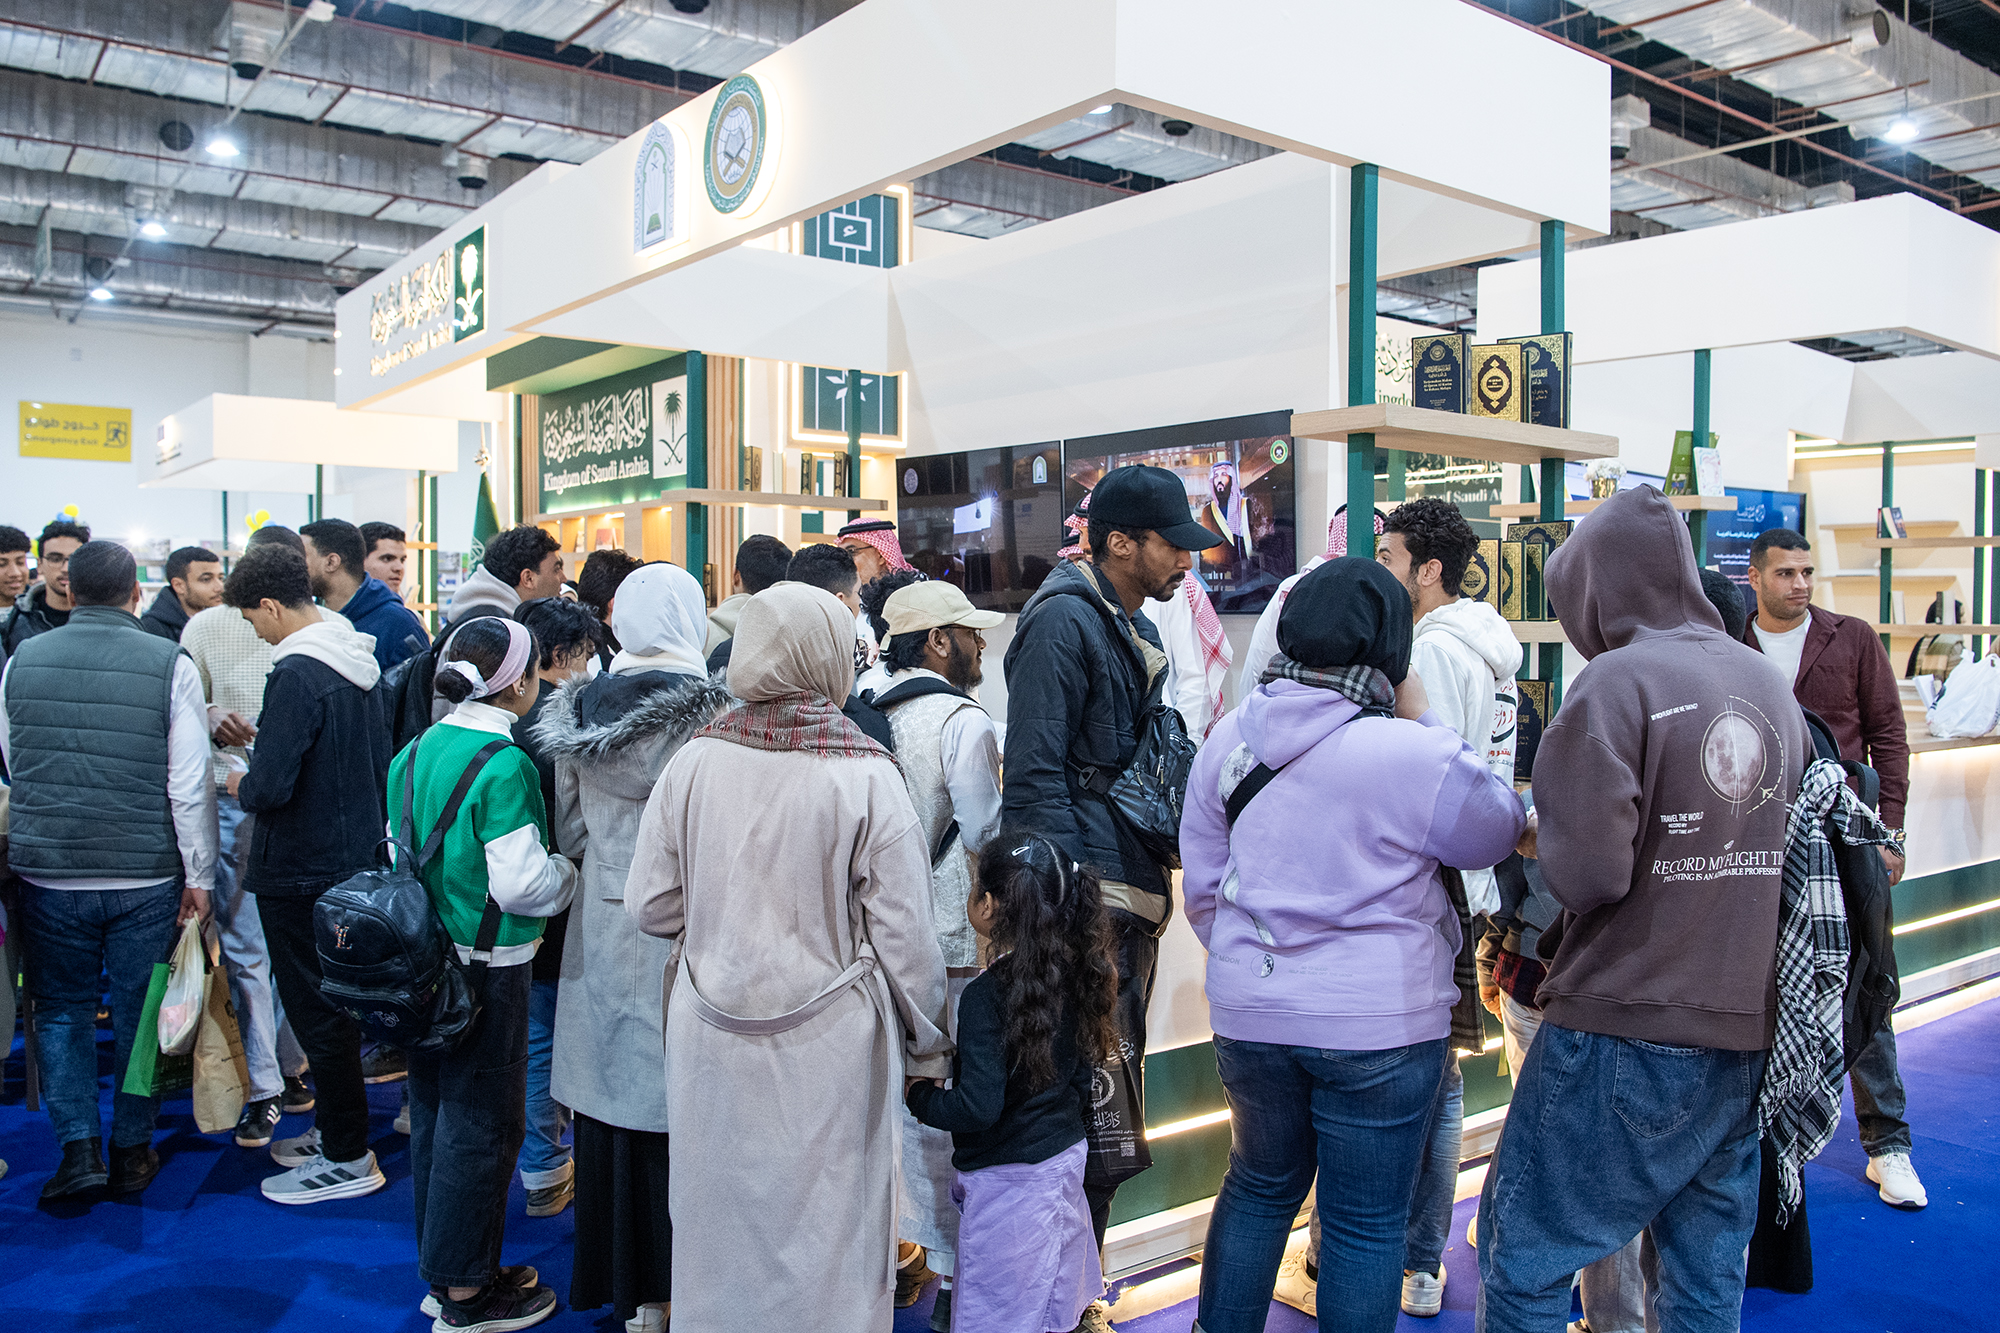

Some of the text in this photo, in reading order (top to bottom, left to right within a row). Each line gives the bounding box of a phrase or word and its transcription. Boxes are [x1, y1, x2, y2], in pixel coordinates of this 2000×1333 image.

[1377, 389, 1413, 407] ingdo
[543, 455, 650, 496] Kingdom of Saudi Arabia
[1453, 488, 1489, 504] Saudi
[1660, 811, 1704, 823] TRAVEL THE WORLD
[1652, 850, 1784, 876] RECORD MY FLIGHT TI
[1663, 873, 1695, 883] PILOTING
[1695, 873, 1703, 881] IS
[1703, 872, 1715, 881] AN
[1219, 954, 1241, 965] MOON
